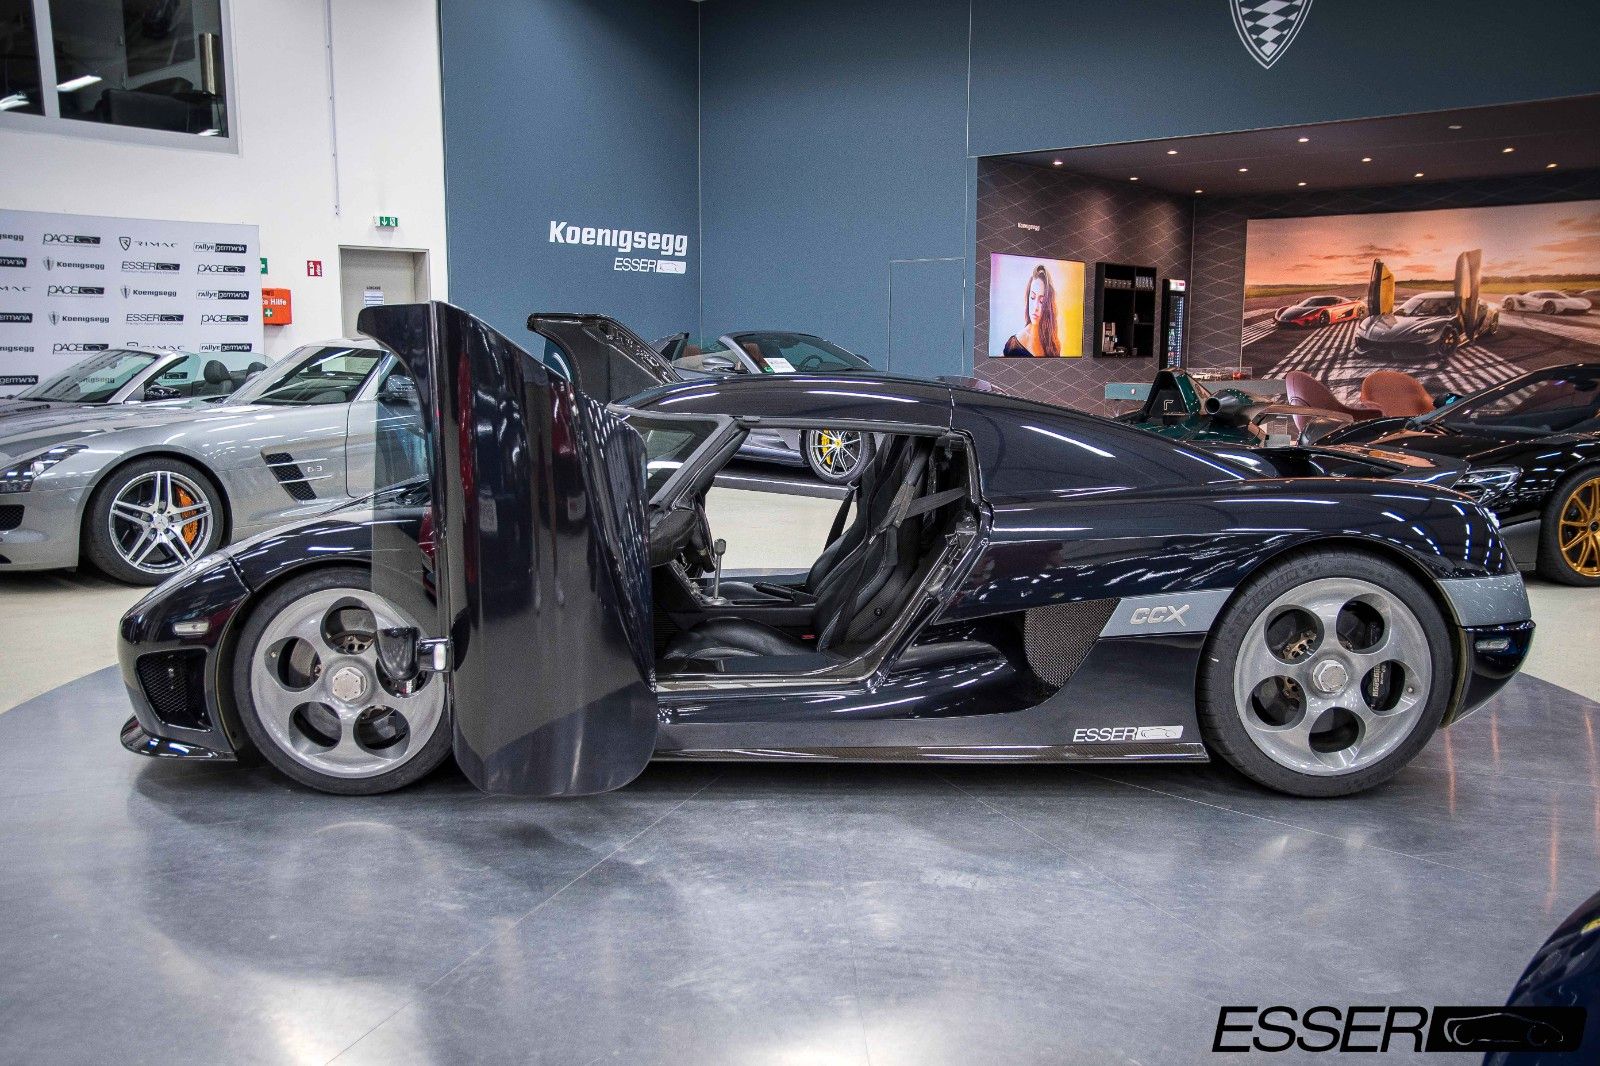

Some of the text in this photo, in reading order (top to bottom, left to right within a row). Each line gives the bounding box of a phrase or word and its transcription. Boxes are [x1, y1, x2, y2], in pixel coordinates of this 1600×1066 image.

[549, 220, 688, 257] Koenigsegg
[56, 261, 105, 270] Koenigsegg
[121, 261, 157, 271] ESSER
[613, 257, 657, 273] ESSER
[132, 289, 177, 298] Koenigsegg
[270, 298, 287, 306] Hilfe
[62, 315, 110, 323] Koenigsegg
[126, 313, 160, 322] ESSER
[1130, 604, 1190, 627] CCX
[1073, 726, 1138, 743] ESSER
